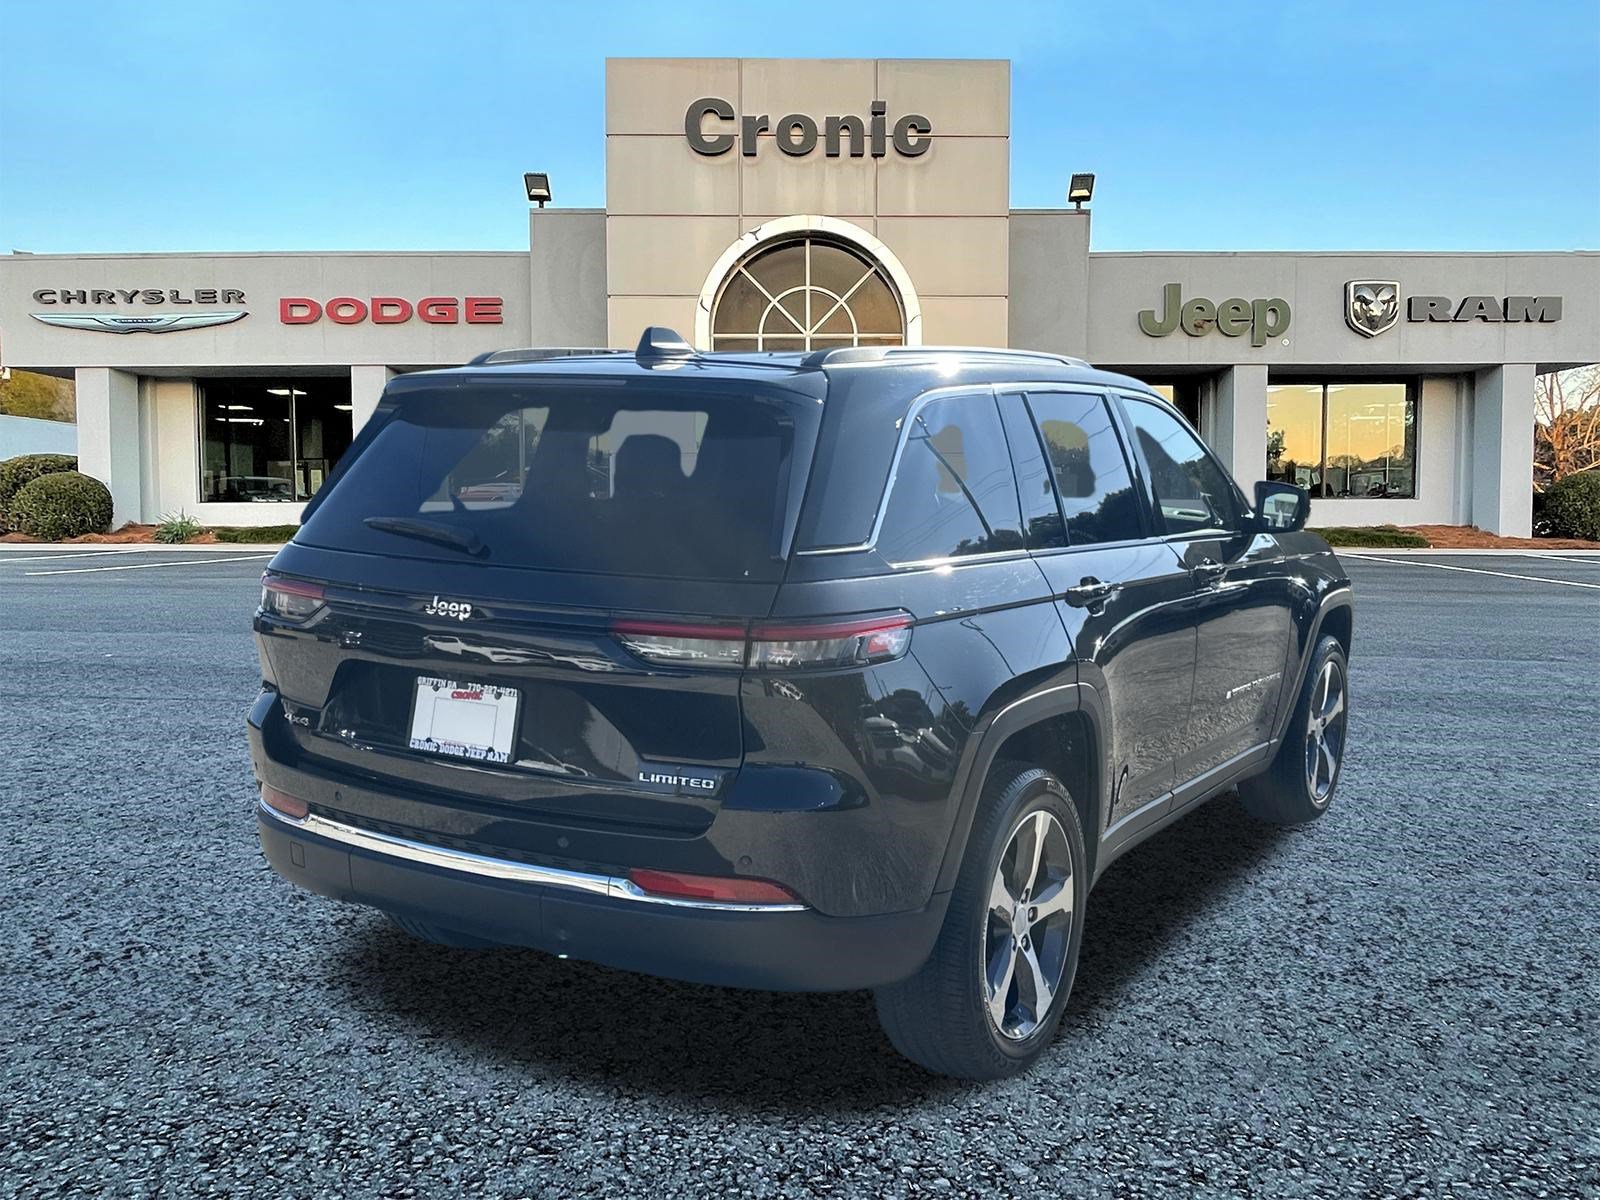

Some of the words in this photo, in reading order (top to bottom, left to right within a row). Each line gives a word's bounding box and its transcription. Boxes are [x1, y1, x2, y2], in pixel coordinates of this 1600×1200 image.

[685, 97, 932, 158] Cronic
[32, 288, 247, 305] CHRYSLER
[1407, 296, 1563, 323] RAM
[279, 297, 504, 325] DODGE
[1138, 283, 1291, 348] Jeep
[425, 595, 472, 621] Jeep
[409, 739, 439, 752] CRONIC
[439, 744, 465, 757] DODGE
[465, 748, 487, 761] JEEP
[487, 750, 508, 763] RAM
[639, 772, 715, 789] LIMITED
